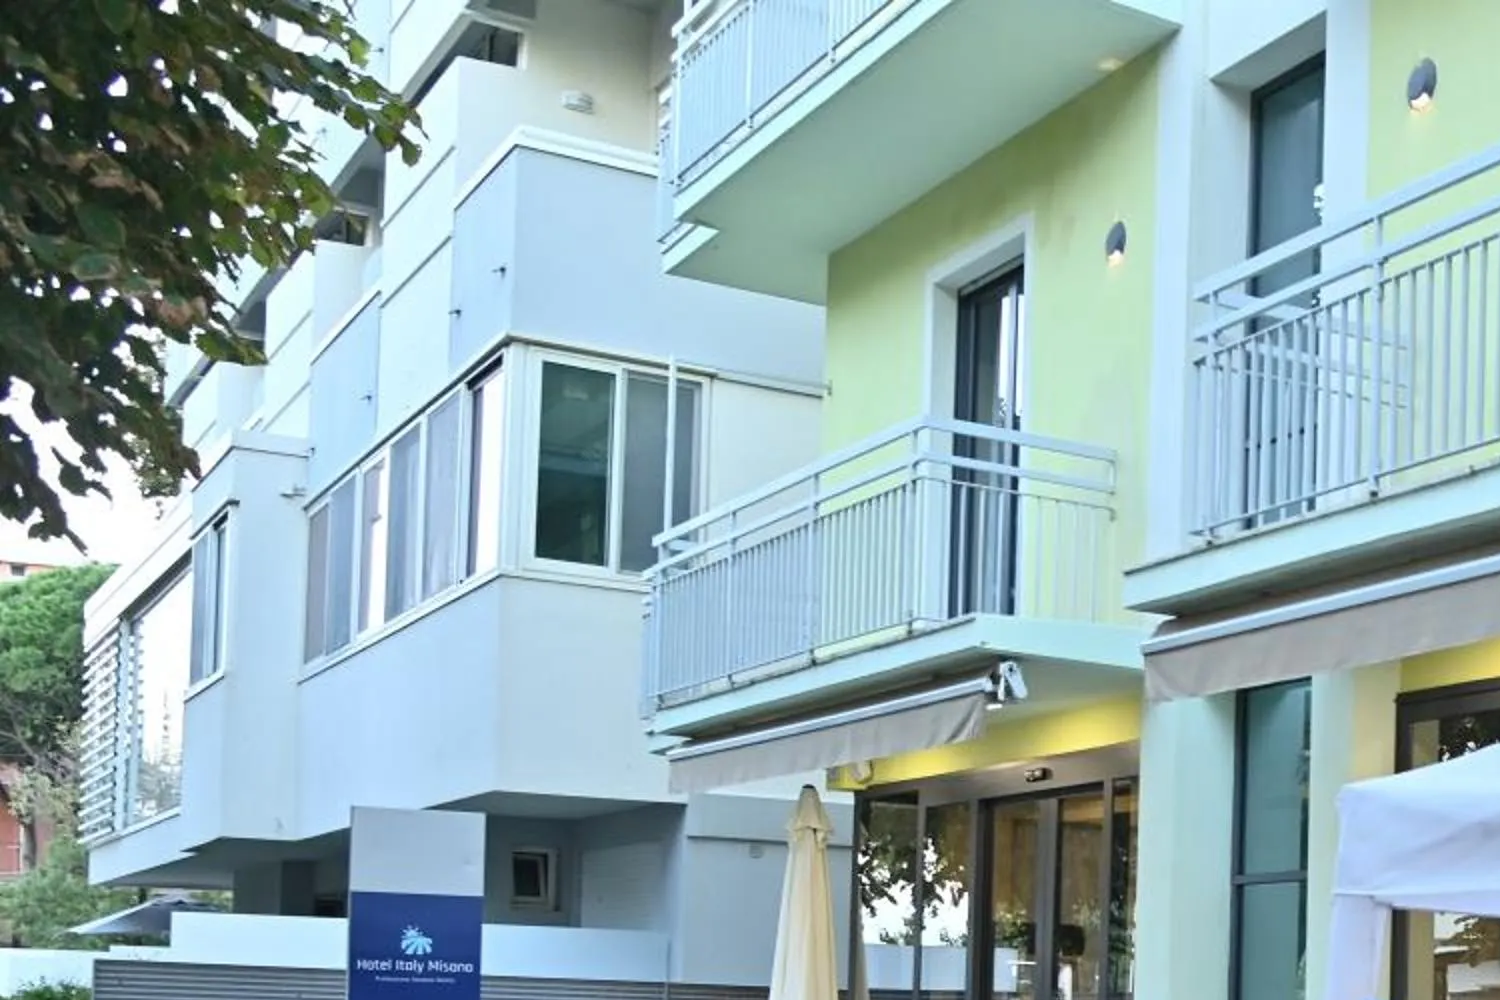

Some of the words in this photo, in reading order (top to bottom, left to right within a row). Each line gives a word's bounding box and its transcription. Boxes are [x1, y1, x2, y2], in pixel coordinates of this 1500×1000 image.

[356, 959, 392, 971] Hotel
[395, 959, 425, 974] Italy
[427, 960, 474, 974] Misano
